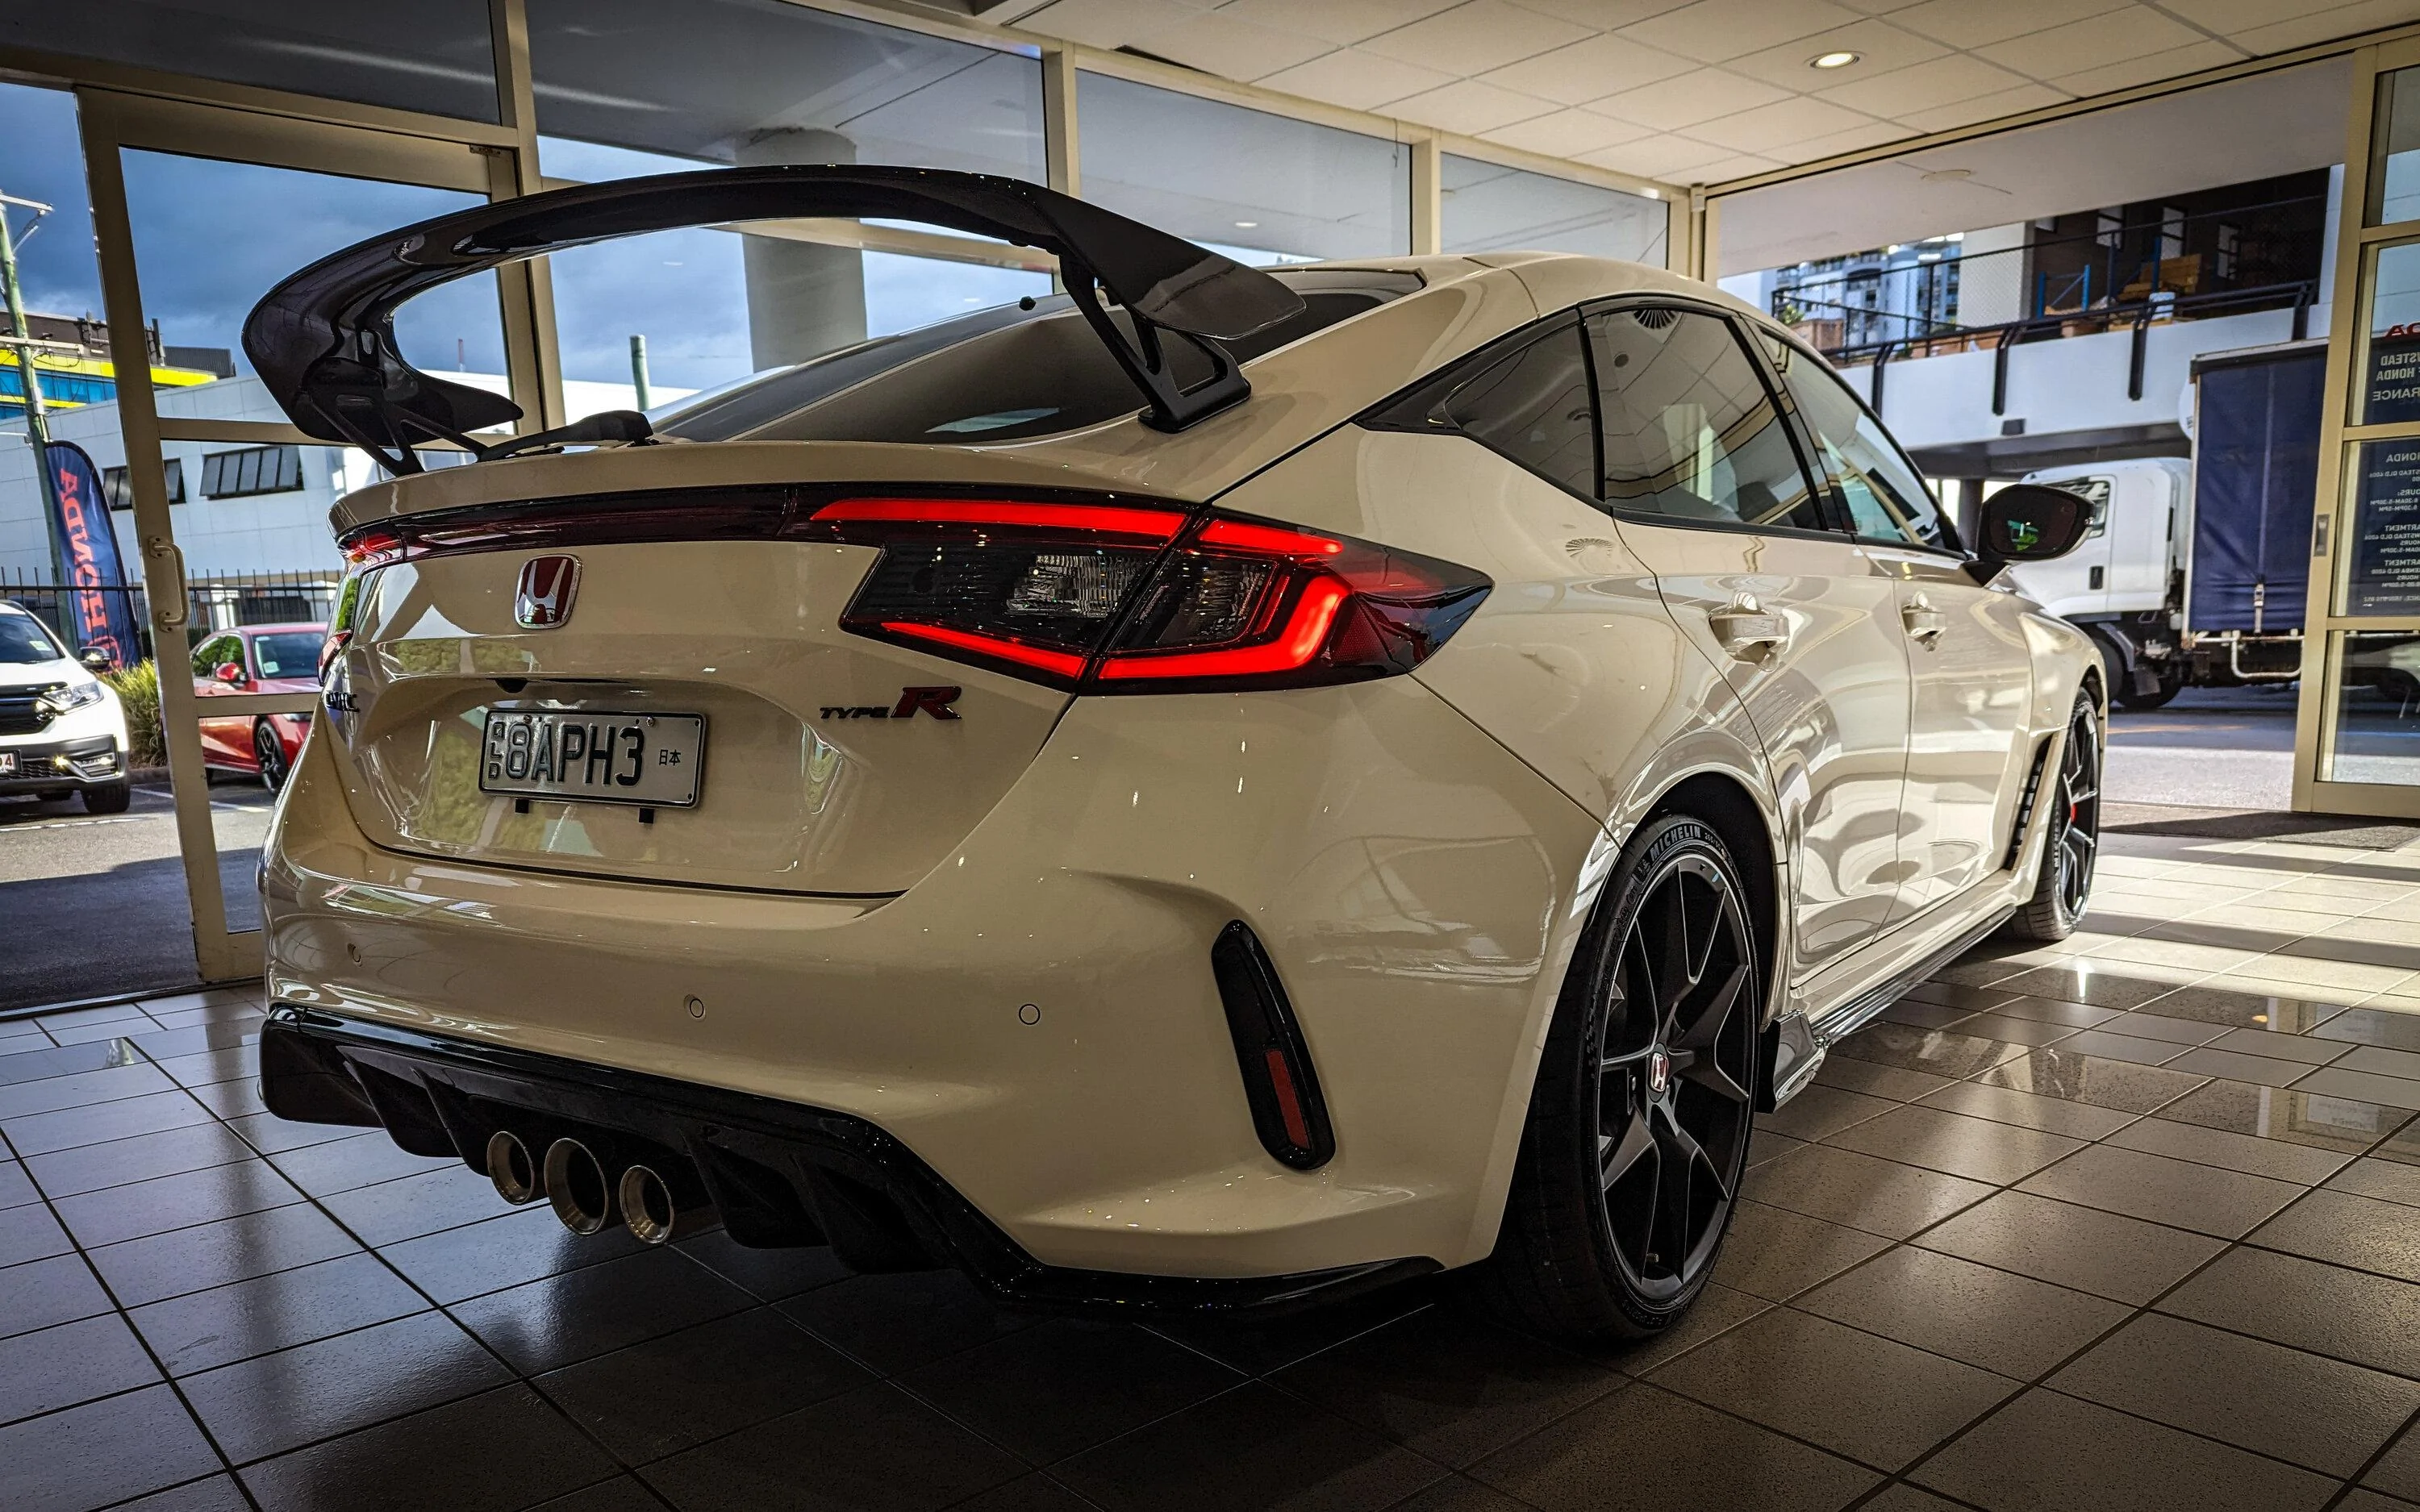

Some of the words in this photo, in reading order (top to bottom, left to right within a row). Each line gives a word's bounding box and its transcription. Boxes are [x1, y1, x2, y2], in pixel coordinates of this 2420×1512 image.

[820, 706, 890, 719] TYPE
[891, 685, 962, 720] R
[505, 722, 645, 786] 8APH3
[658, 749, 682, 766] 日本
[1650, 825, 1701, 862] MICHELIN
